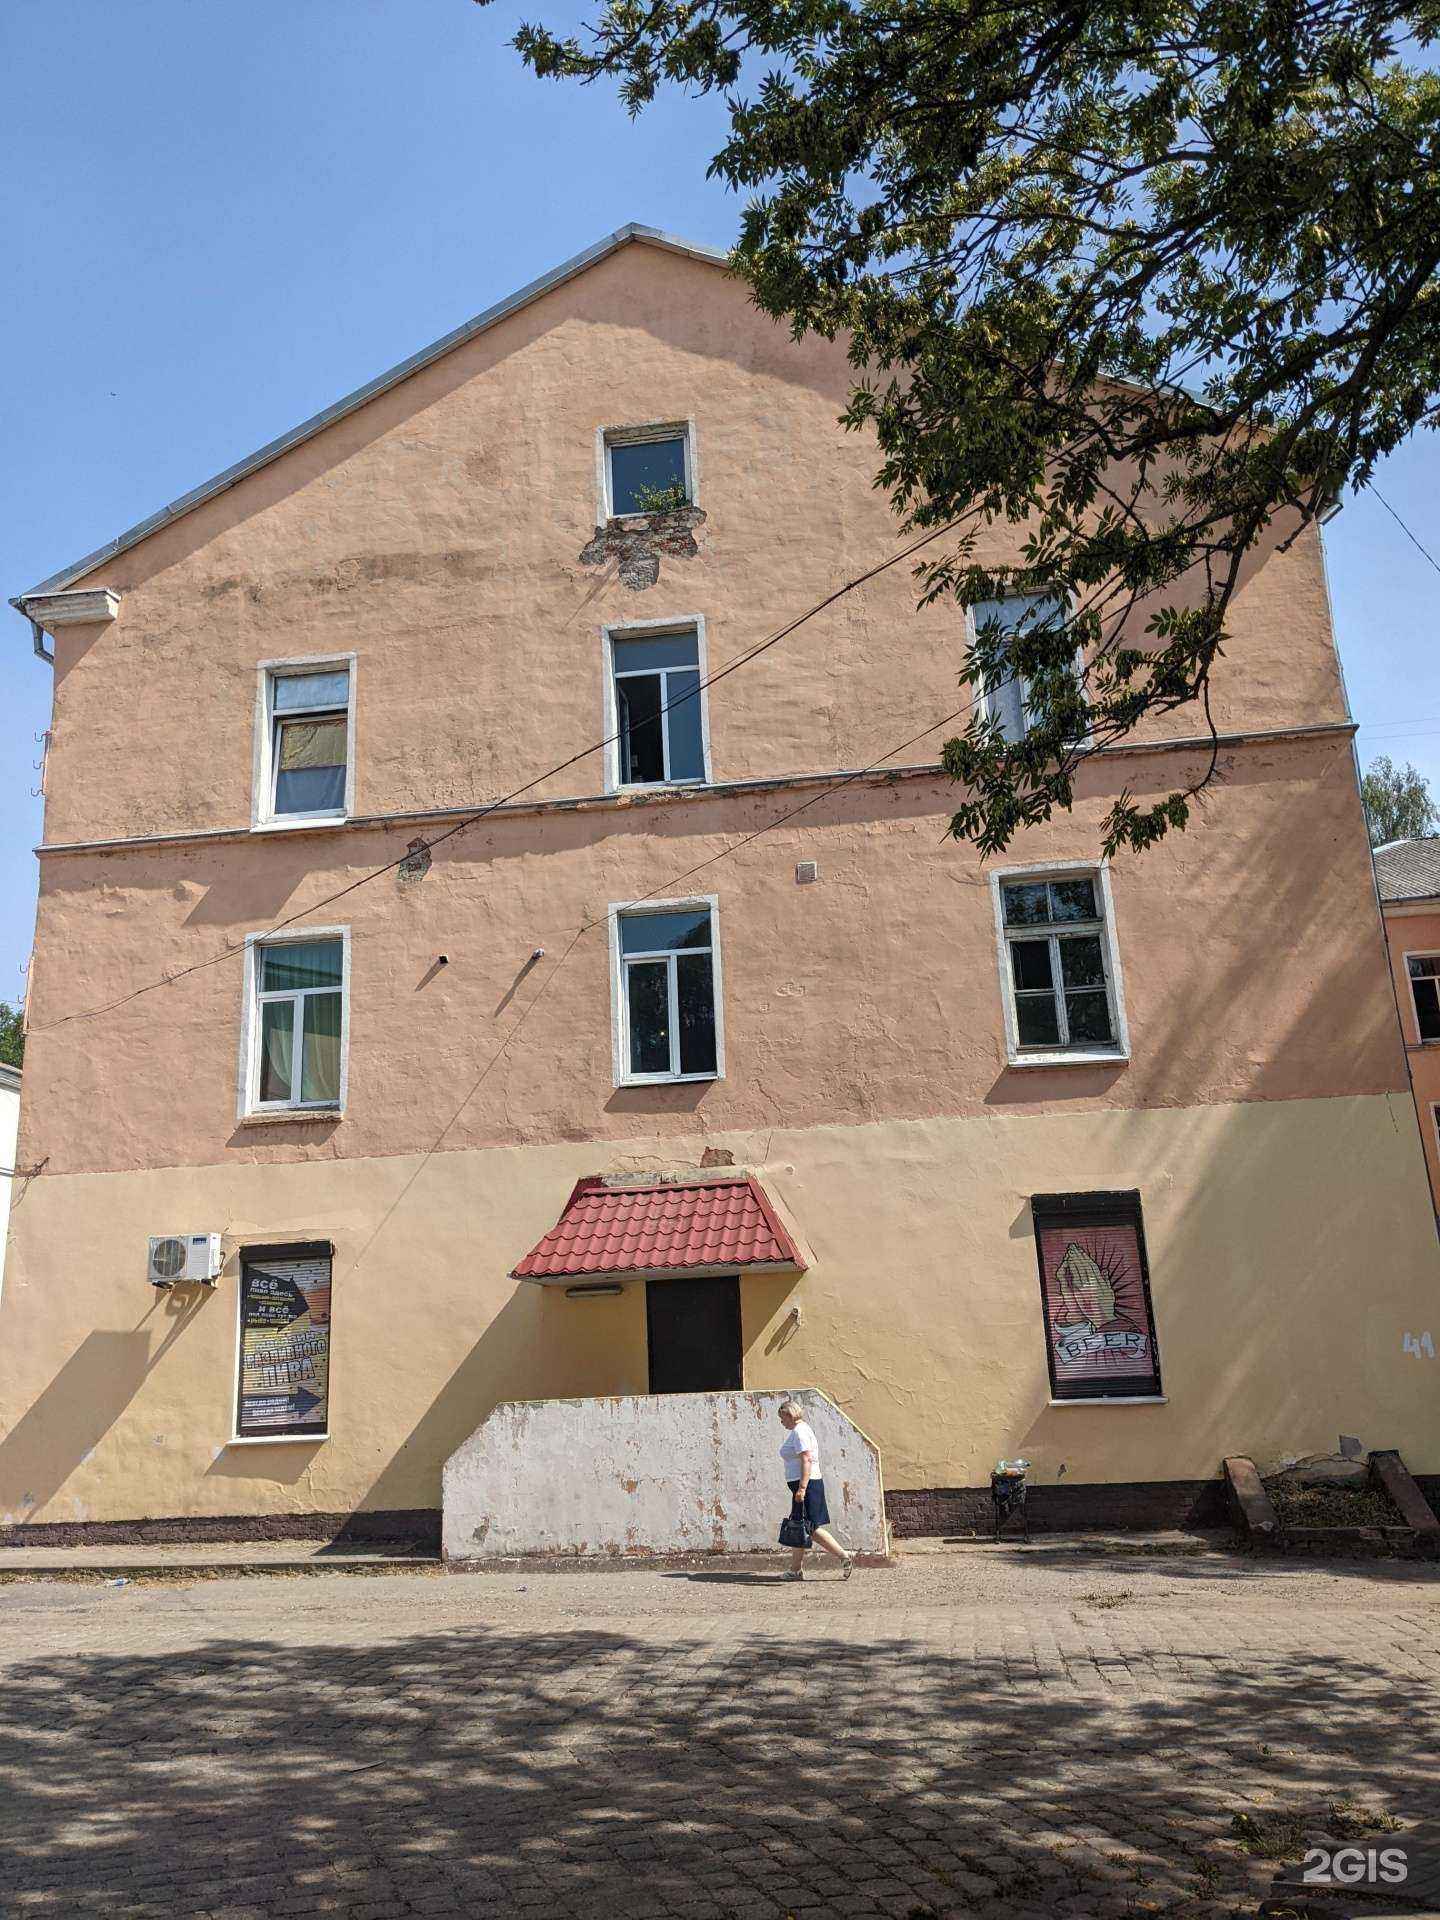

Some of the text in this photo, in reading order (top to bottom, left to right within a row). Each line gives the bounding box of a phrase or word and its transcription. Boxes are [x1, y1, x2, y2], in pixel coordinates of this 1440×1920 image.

[245, 1339, 326, 1368] РАЗЛИВНОГО
[1066, 1331, 1140, 1358] BEER
[262, 1358, 315, 1387] ПИВА
